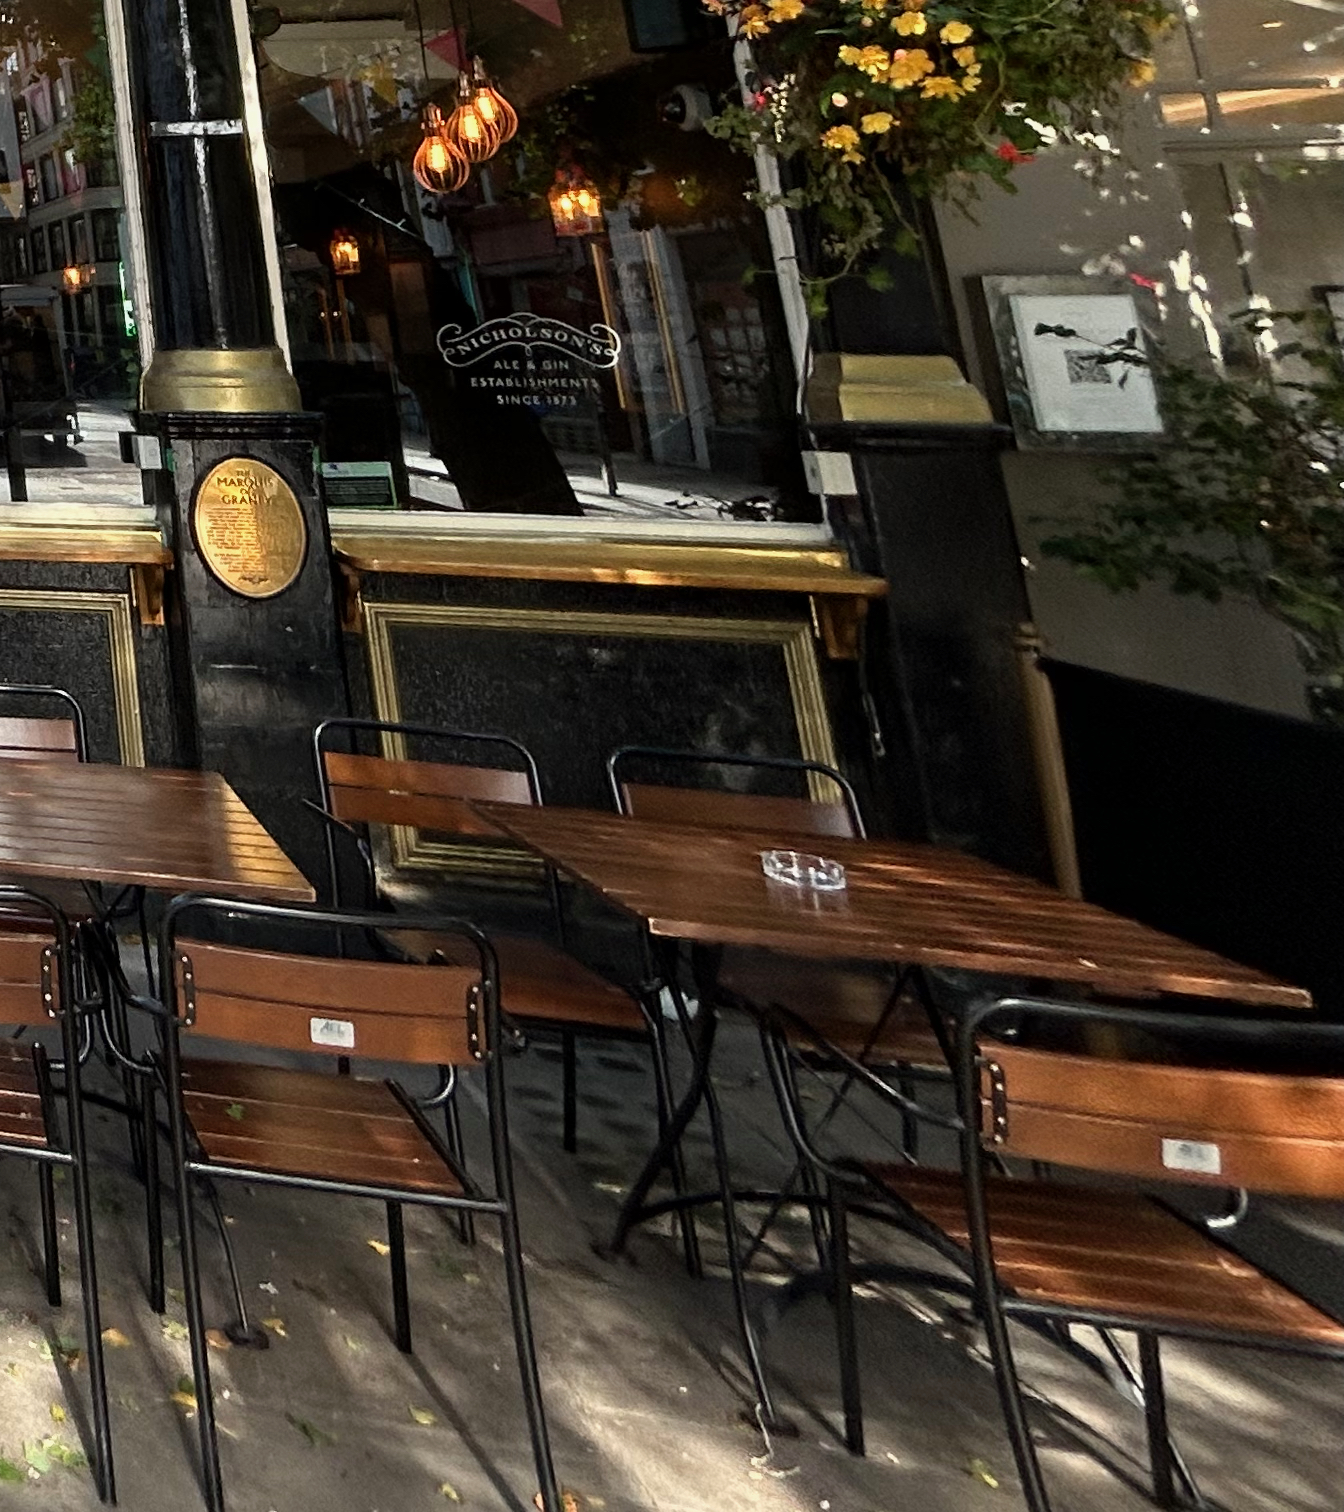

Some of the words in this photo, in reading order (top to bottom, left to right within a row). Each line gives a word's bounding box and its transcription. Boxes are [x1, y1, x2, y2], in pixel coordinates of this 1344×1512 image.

[456, 327, 604, 356] NICHOLSON'S
[493, 360, 520, 370] ALE
[542, 360, 569, 370] GIN
[470, 377, 601, 389] ESTABLISHMENTS
[496, 395, 541, 405] SINCE
